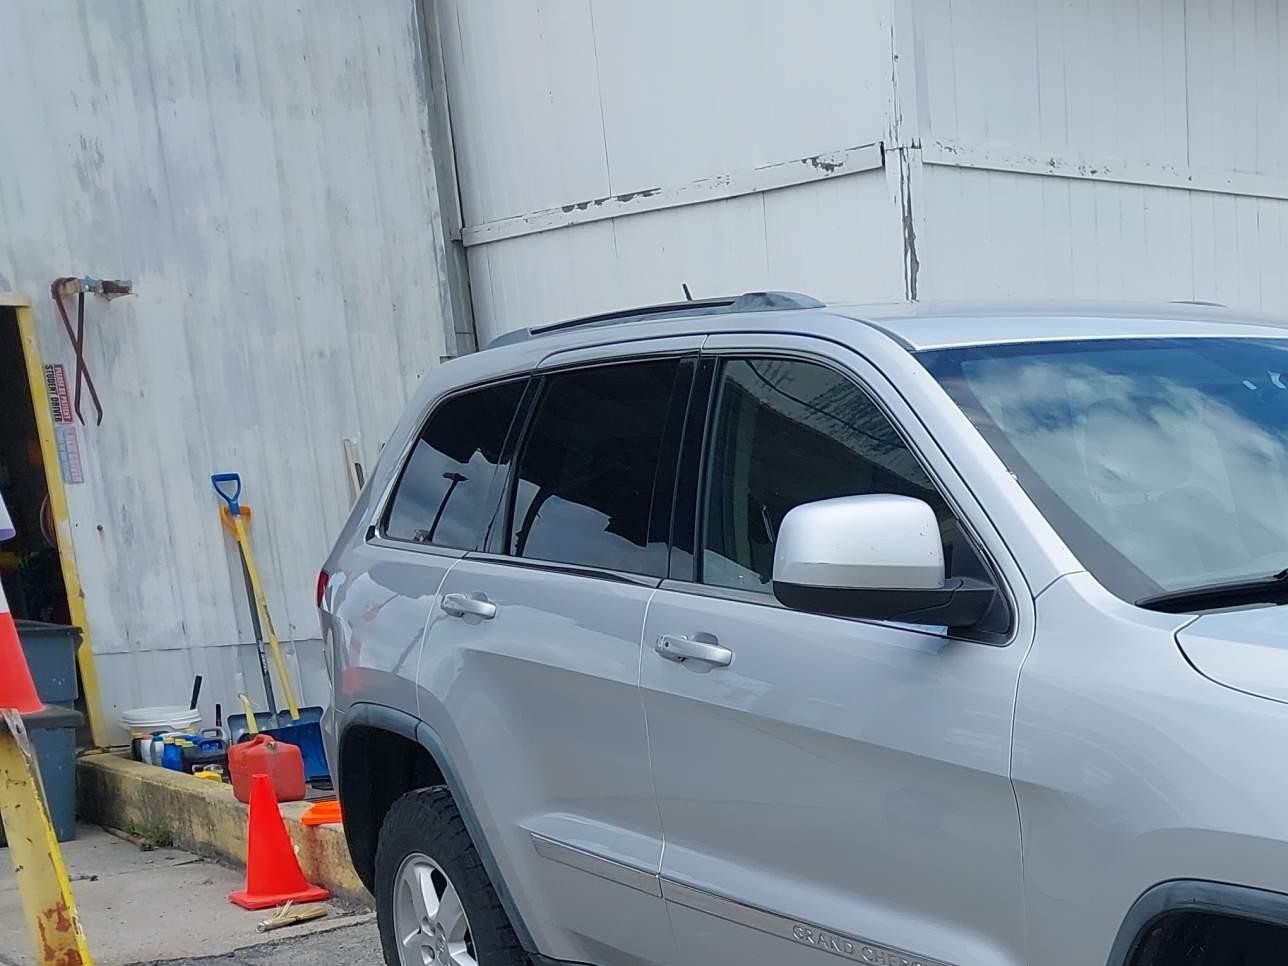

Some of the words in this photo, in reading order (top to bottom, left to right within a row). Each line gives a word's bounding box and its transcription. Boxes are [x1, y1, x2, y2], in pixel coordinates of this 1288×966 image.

[45, 364, 58, 396] STUDENT
[51, 397, 62, 422] DRIVER
[792, 924, 855, 955] GRAND
